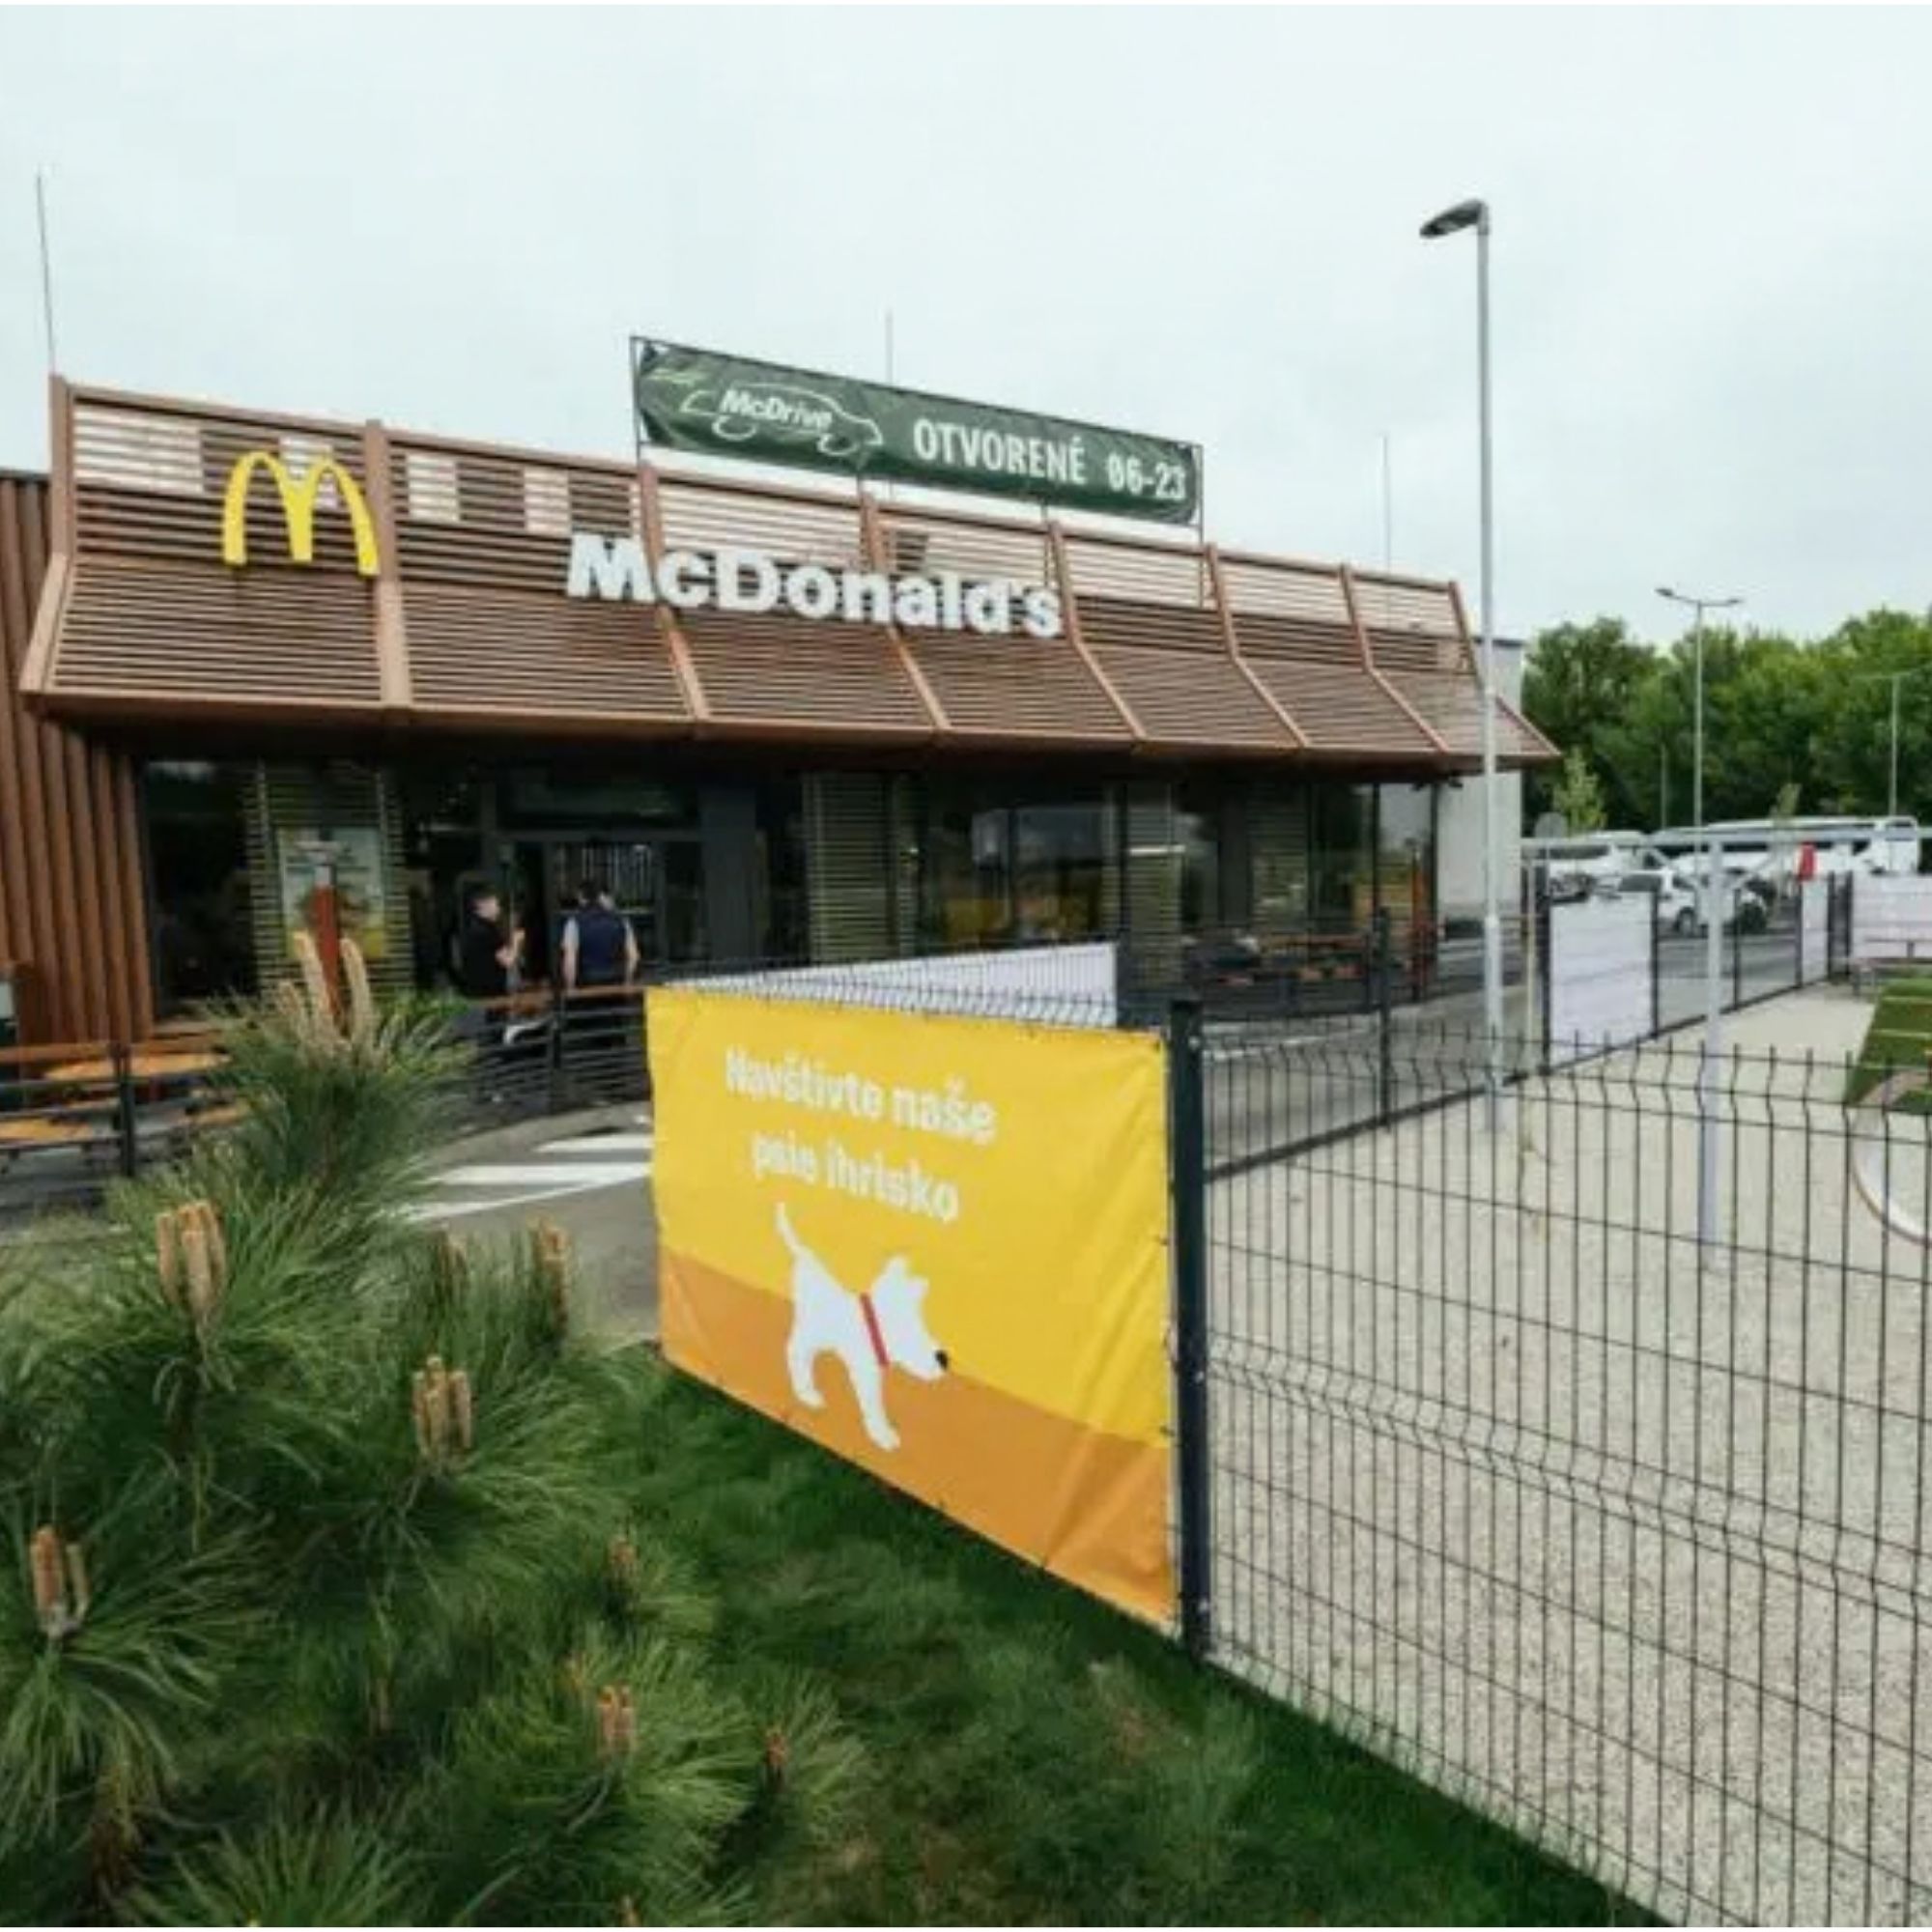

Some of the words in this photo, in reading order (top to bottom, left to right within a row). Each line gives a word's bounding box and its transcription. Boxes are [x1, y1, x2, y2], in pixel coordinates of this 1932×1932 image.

[720, 388, 832, 431] McDrive
[914, 418, 1088, 485] OTVORENÉ
[1105, 452, 1186, 500] 06-23
[566, 532, 1062, 638] McDonald's
[892, 1074, 997, 1146] naše
